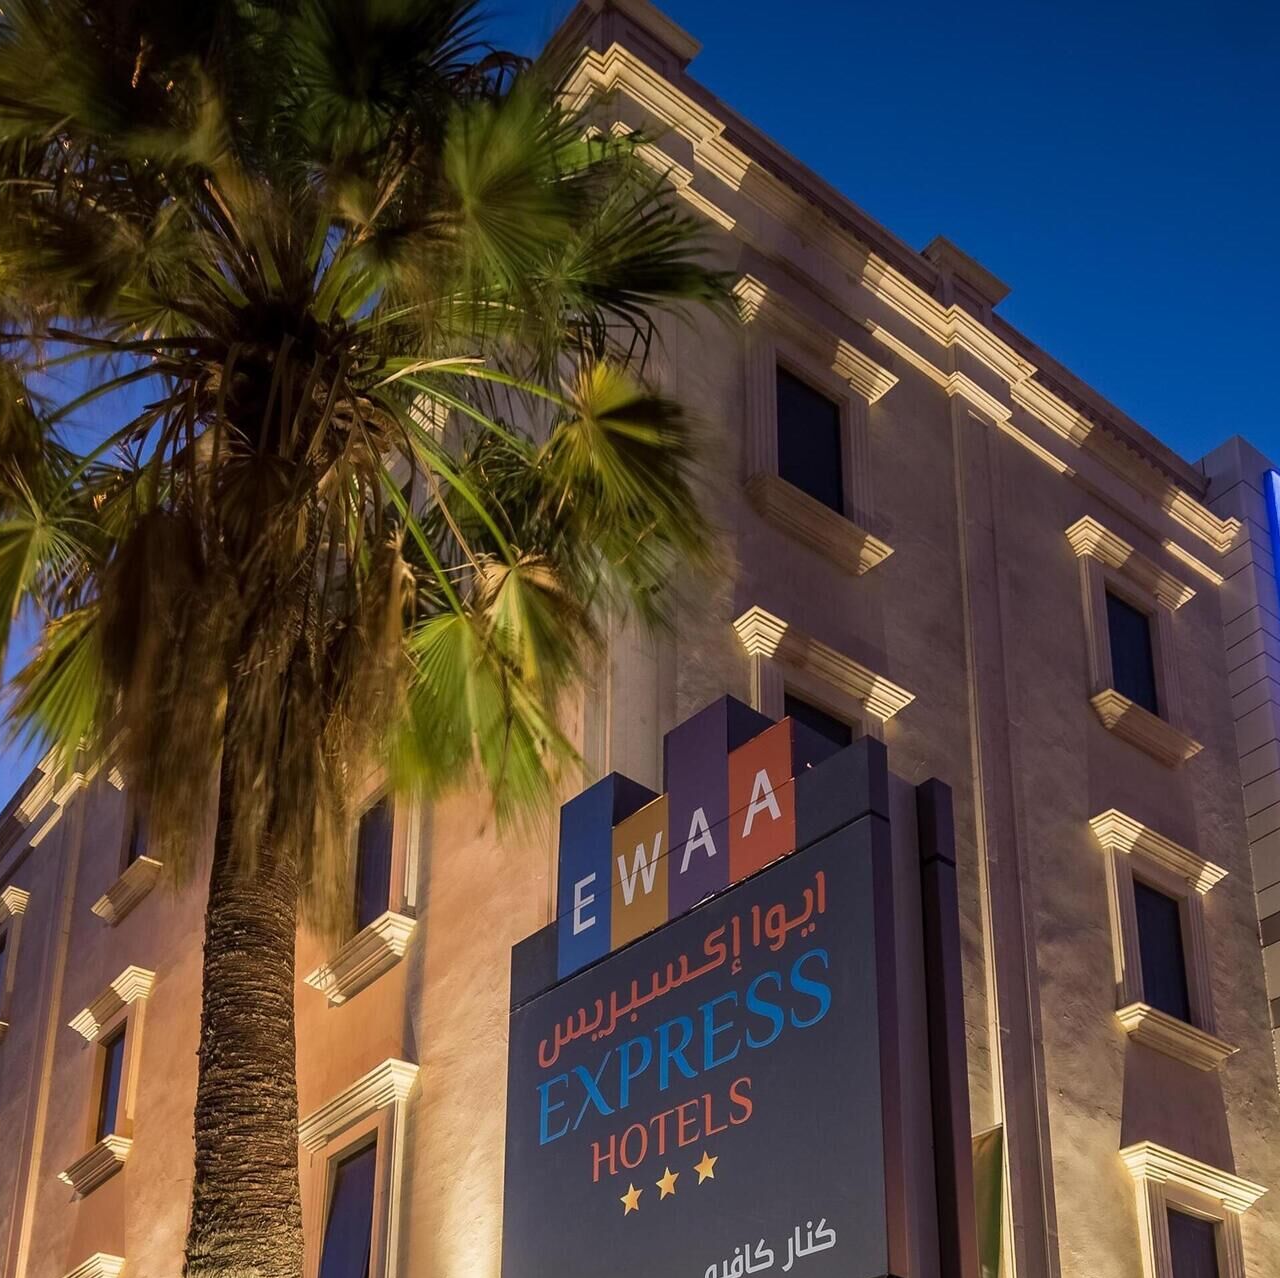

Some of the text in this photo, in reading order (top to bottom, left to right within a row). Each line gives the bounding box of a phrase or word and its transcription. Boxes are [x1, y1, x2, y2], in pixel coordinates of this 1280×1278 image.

[572, 768, 782, 936] EWAA
[535, 948, 832, 1145] EXPRESS
[591, 1076, 754, 1182] HOTELS
[782, 1218, 837, 1272] كنار
